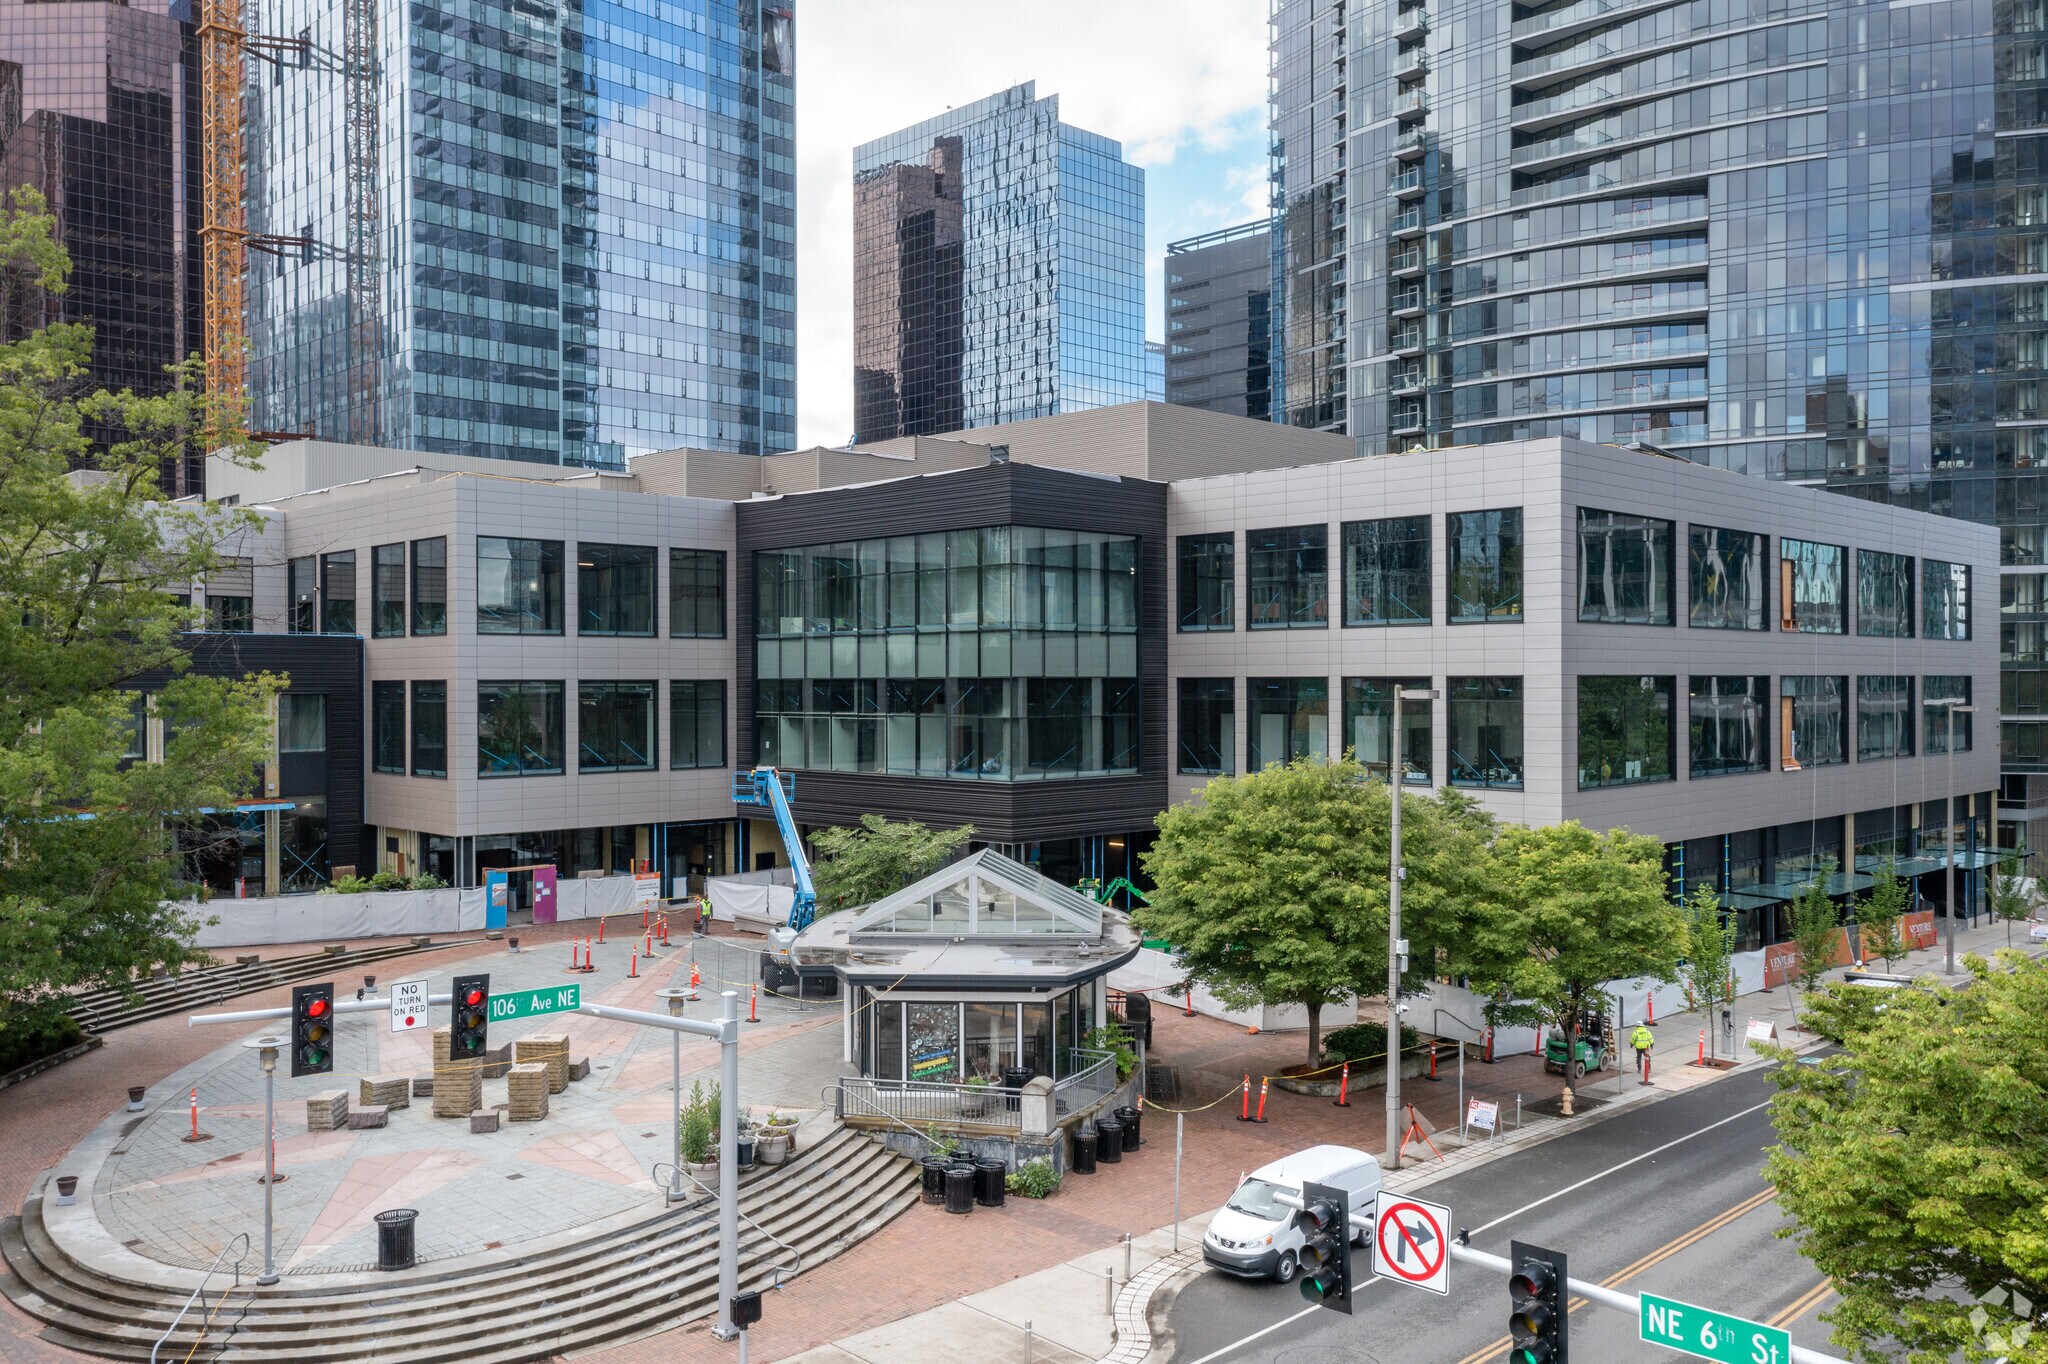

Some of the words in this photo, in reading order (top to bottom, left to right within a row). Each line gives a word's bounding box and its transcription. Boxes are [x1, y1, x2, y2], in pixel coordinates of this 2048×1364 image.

[1909, 922, 1932, 934] VENTURE
[401, 985, 418, 995] NO
[399, 996, 421, 1006] TURN
[530, 994, 552, 1012] Ave
[558, 989, 576, 1008] NE
[393, 1008, 406, 1016] ON
[409, 1005, 426, 1014] RED
[1649, 1303, 1684, 1341] NE
[1700, 1320, 1735, 1350] 6th
[1751, 1333, 1779, 1364] St
